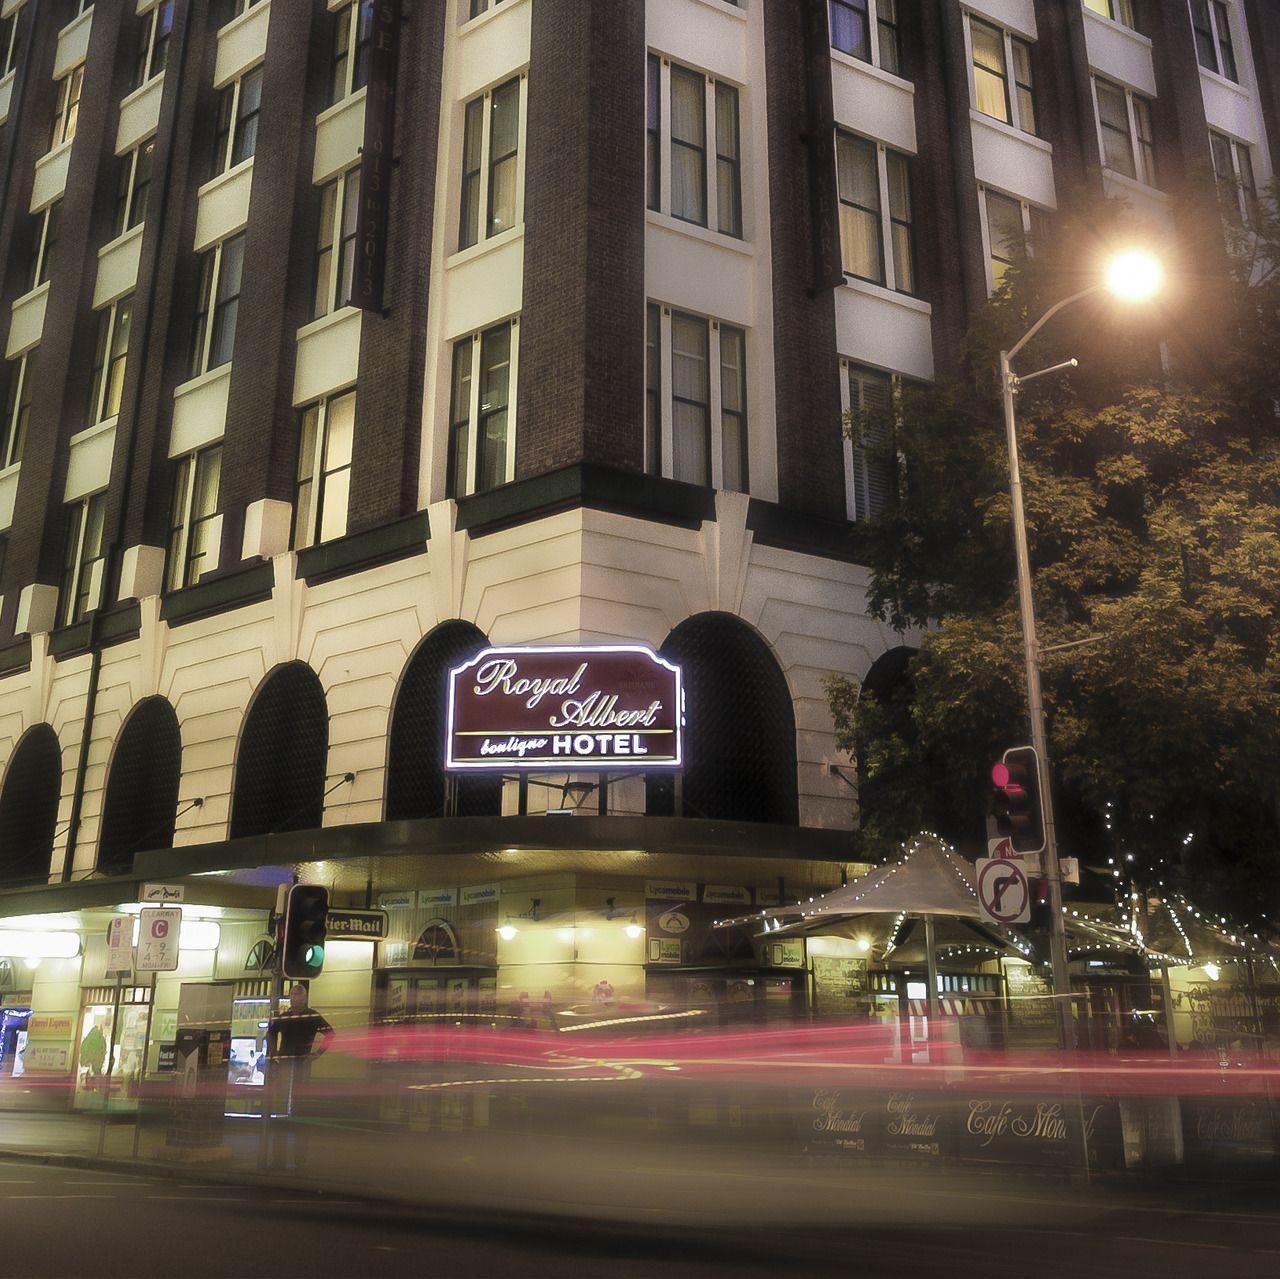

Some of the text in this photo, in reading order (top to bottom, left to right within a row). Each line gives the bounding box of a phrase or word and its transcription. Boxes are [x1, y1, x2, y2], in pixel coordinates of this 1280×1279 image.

[474, 658, 589, 709] Royal
[549, 691, 663, 727] Albert
[480, 734, 648, 757] boutique HOTEL
[421, 894, 452, 905] Lycamobile
[463, 888, 496, 901] Lycamobile
[649, 886, 691, 897] Lycamobile
[381, 897, 410, 906] Lycamobile
[143, 910, 180, 918] CLEARWAY
[155, 921, 166, 937] C
[660, 942, 681, 953] Lyca
[783, 955, 801, 963] mobile
[812, 1087, 841, 1113] Café
[886, 1091, 915, 1114] Café
[812, 1111, 868, 1132] Mondial
[887, 1113, 941, 1136] Mondial
[967, 1099, 1012, 1147] Café
